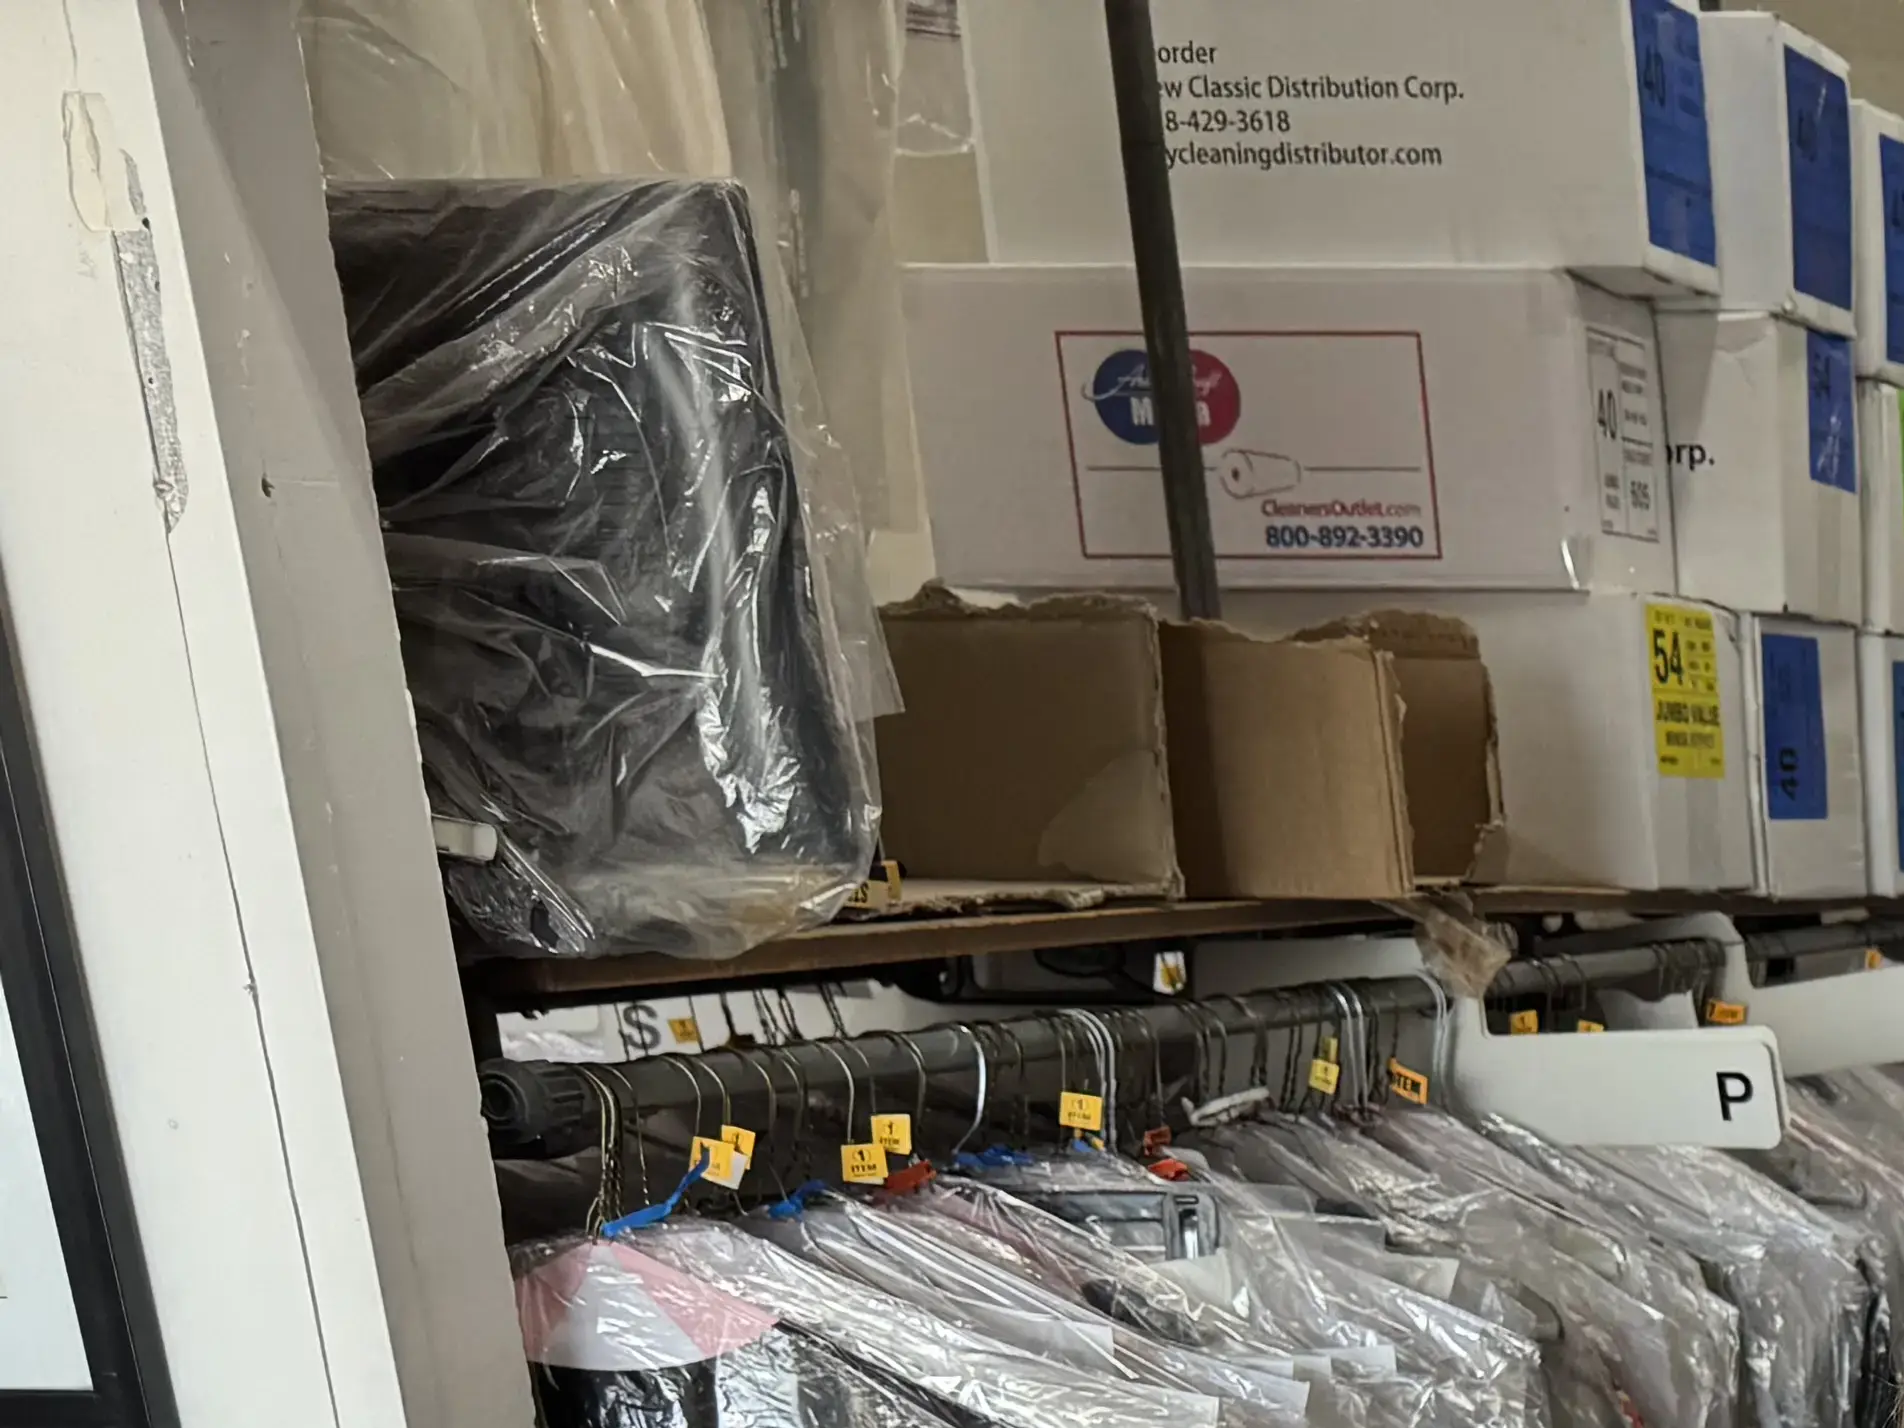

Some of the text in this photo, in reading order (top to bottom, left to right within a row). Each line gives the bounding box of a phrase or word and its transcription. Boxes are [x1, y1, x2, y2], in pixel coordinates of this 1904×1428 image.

[1157, 40, 1217, 64] order
[1188, 75, 1262, 99] Classic
[1268, 75, 1399, 99] Distribution
[1404, 75, 1464, 104] Corp.
[1165, 109, 1291, 132] 8-429-3618
[1164, 140, 1443, 171] ycleaningdistributor.com
[1597, 388, 1618, 440] 40
[1665, 443, 1716, 472] rp.
[1261, 499, 1422, 518] CleanersOutlet.com
[1265, 525, 1424, 548] 800-892-3390
[1652, 628, 1684, 686] 54
[622, 1004, 662, 1050] S
[1716, 1071, 1754, 1121] P
[850, 1163, 877, 1173] ITEM
